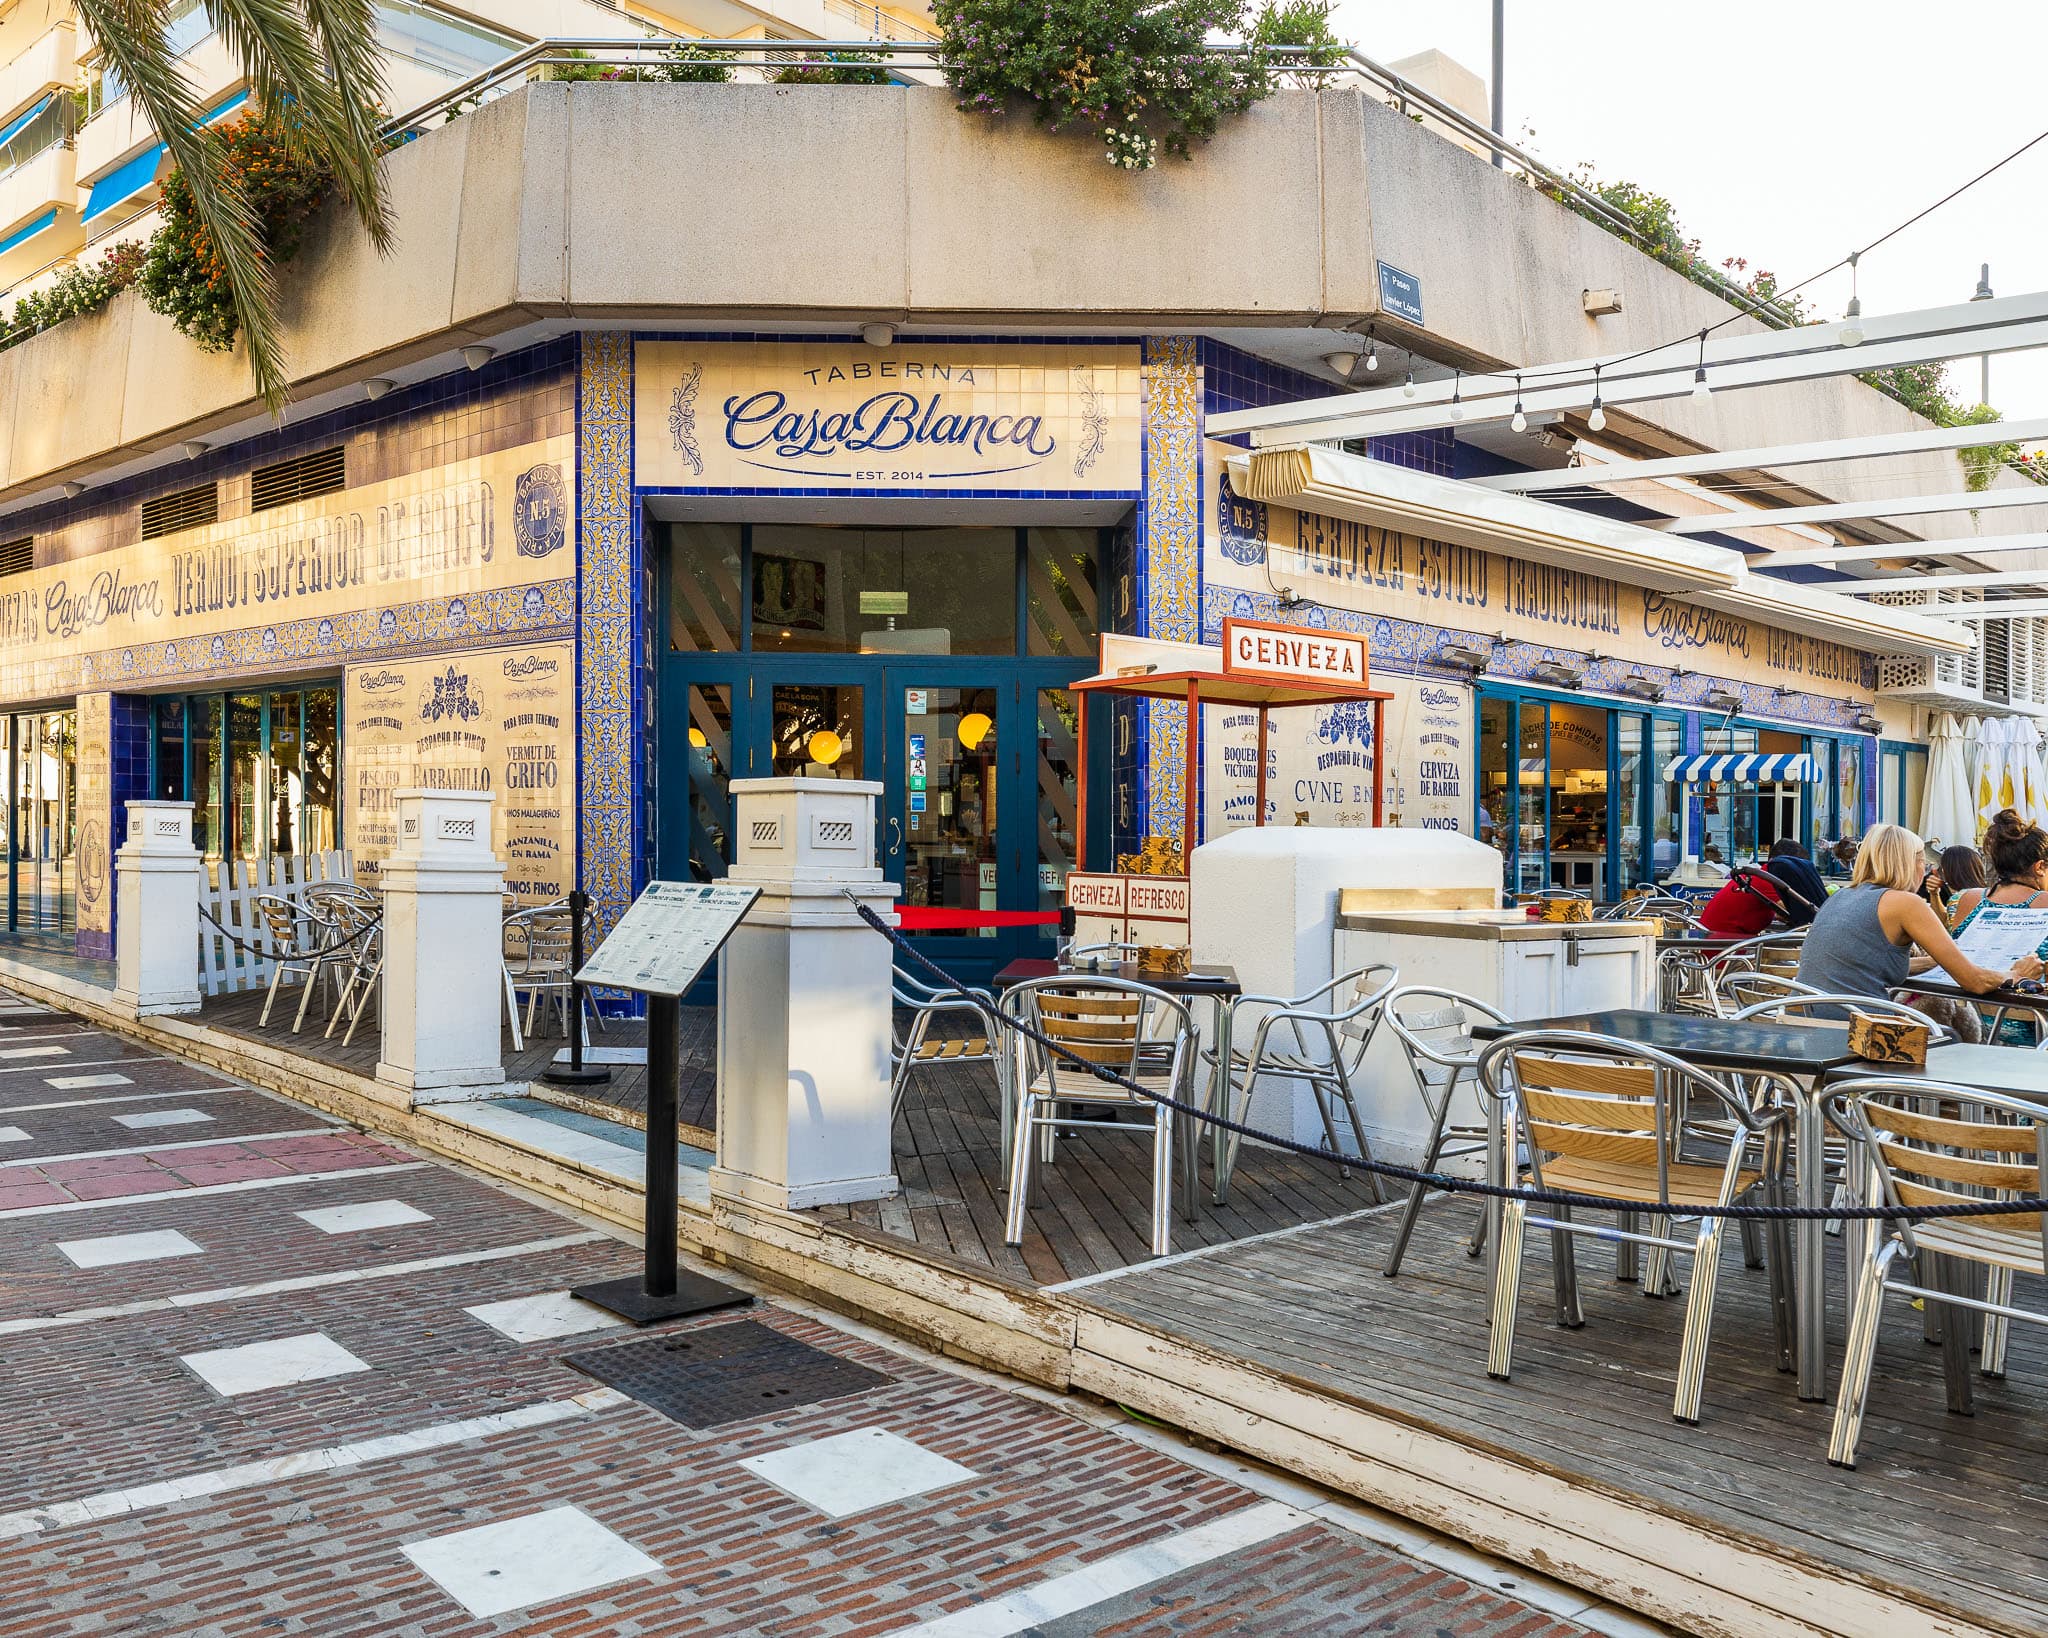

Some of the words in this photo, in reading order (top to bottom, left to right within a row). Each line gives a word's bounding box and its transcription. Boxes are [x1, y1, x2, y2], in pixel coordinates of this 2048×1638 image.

[1392, 276, 1410, 291] Paseo
[804, 361, 976, 386] TABERNA
[855, 471, 886, 480] EST.
[891, 471, 924, 480] 2014
[171, 540, 250, 617] VERMUT
[253, 512, 366, 604] SUPERIOR
[377, 502, 407, 582] DE
[413, 482, 495, 574] GRIFO
[1293, 508, 1404, 591] CERVEZA
[1416, 536, 1488, 608] ESTILO
[1503, 555, 1621, 636] TRADICIONAL
[0, 588, 38, 645] EZAS
[1239, 635, 1355, 675] CERVEZA
[1766, 625, 1803, 673] TAPAS
[504, 716, 517, 732] PARA
[535, 713, 560, 729] TENEMOS
[1222, 716, 1237, 730] PARA
[1237, 714, 1255, 726] COMER
[416, 730, 451, 754] DESPACHO
[453, 731, 462, 746] DE
[464, 731, 486, 753] VINOS
[1562, 721, 1604, 745] COMIDAS
[506, 745, 543, 761] VERMUT
[545, 744, 557, 760] DE
[1224, 746, 1277, 764] BOQUERES
[1317, 750, 1351, 771] DESPACHO
[1352, 751, 1361, 767] DE
[505, 761, 558, 789] GRIFO
[1224, 763, 1277, 779] VICTORIOS
[1420, 760, 1460, 780] CERVEZA
[1294, 779, 1344, 804] CVNE
[1353, 785, 1405, 805] ENTE
[1420, 780, 1431, 796] DE
[1432, 781, 1461, 797] BARRIL
[1223, 795, 1277, 812] JAMOES
[520, 808, 560, 819] MALAGUEÑOS
[1227, 813, 1246, 821] PARA
[1248, 814, 1273, 822] LLAR
[1421, 817, 1459, 831] VINOS
[505, 836, 560, 852] MANZANILLA
[511, 849, 523, 858] EN
[525, 850, 552, 859] RAMA
[357, 860, 379, 873] TAPAS
[503, 880, 531, 895] VINOS
[533, 881, 560, 897] FINOS
[1072, 884, 1122, 907] CERVEZA
[1130, 886, 1186, 911] REFRESCO
